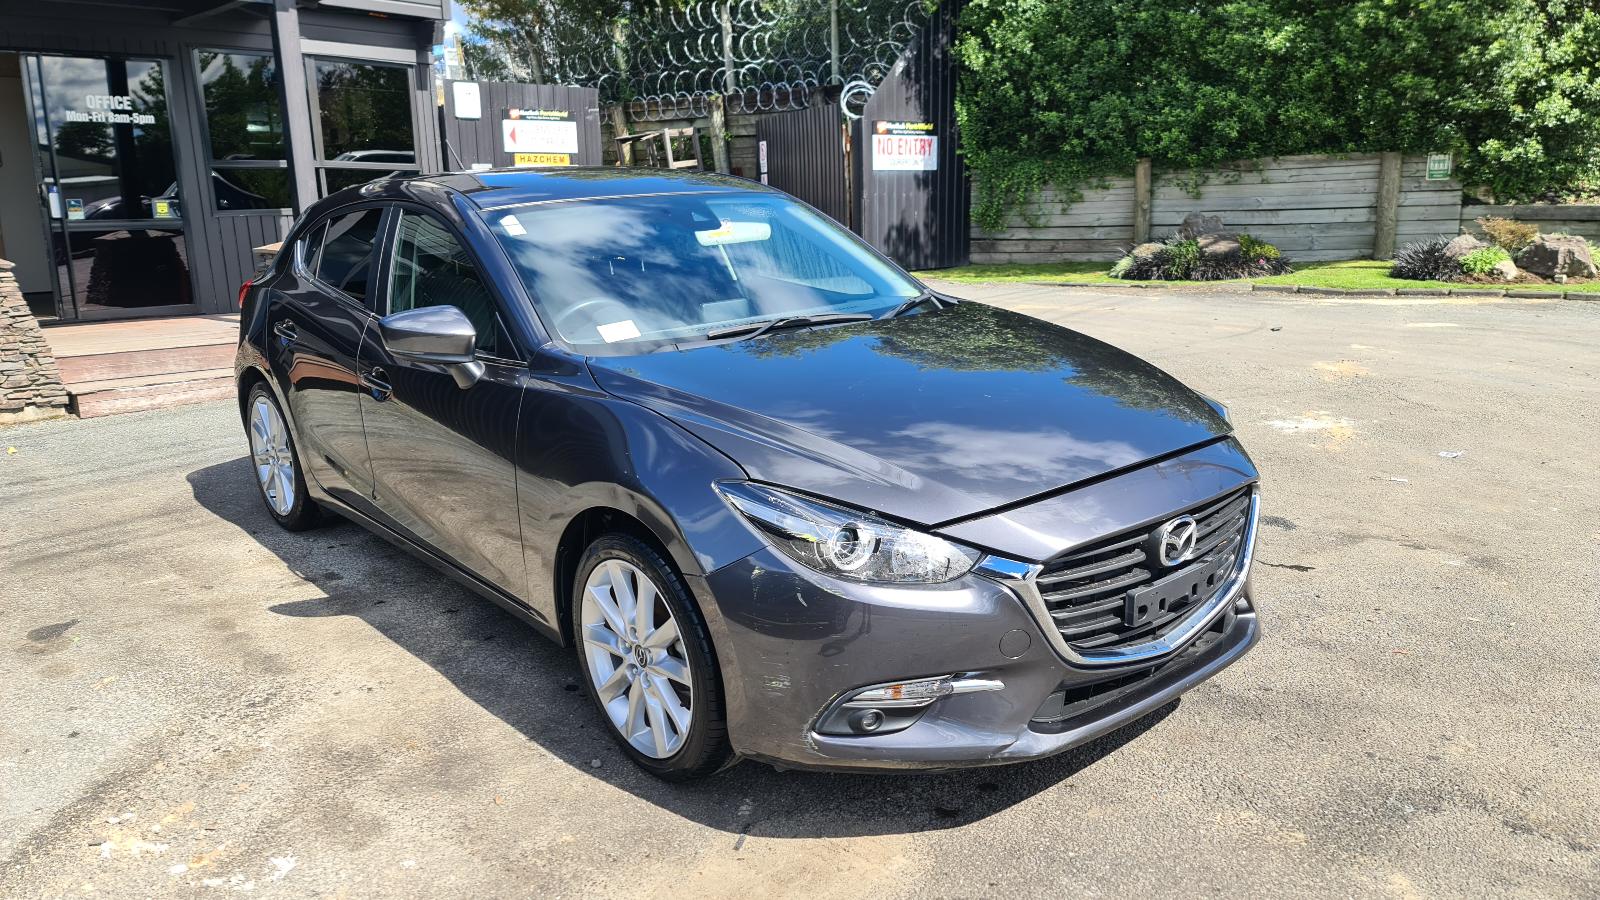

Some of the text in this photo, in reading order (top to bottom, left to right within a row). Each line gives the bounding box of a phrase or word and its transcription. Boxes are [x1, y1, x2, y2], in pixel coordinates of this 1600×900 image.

[87, 95, 132, 110] OFFICE
[66, 111, 155, 124] Mon-Fri 8am-5pm
[878, 138, 933, 156] NO ENTRY
[519, 155, 565, 163] HAZCHEM
